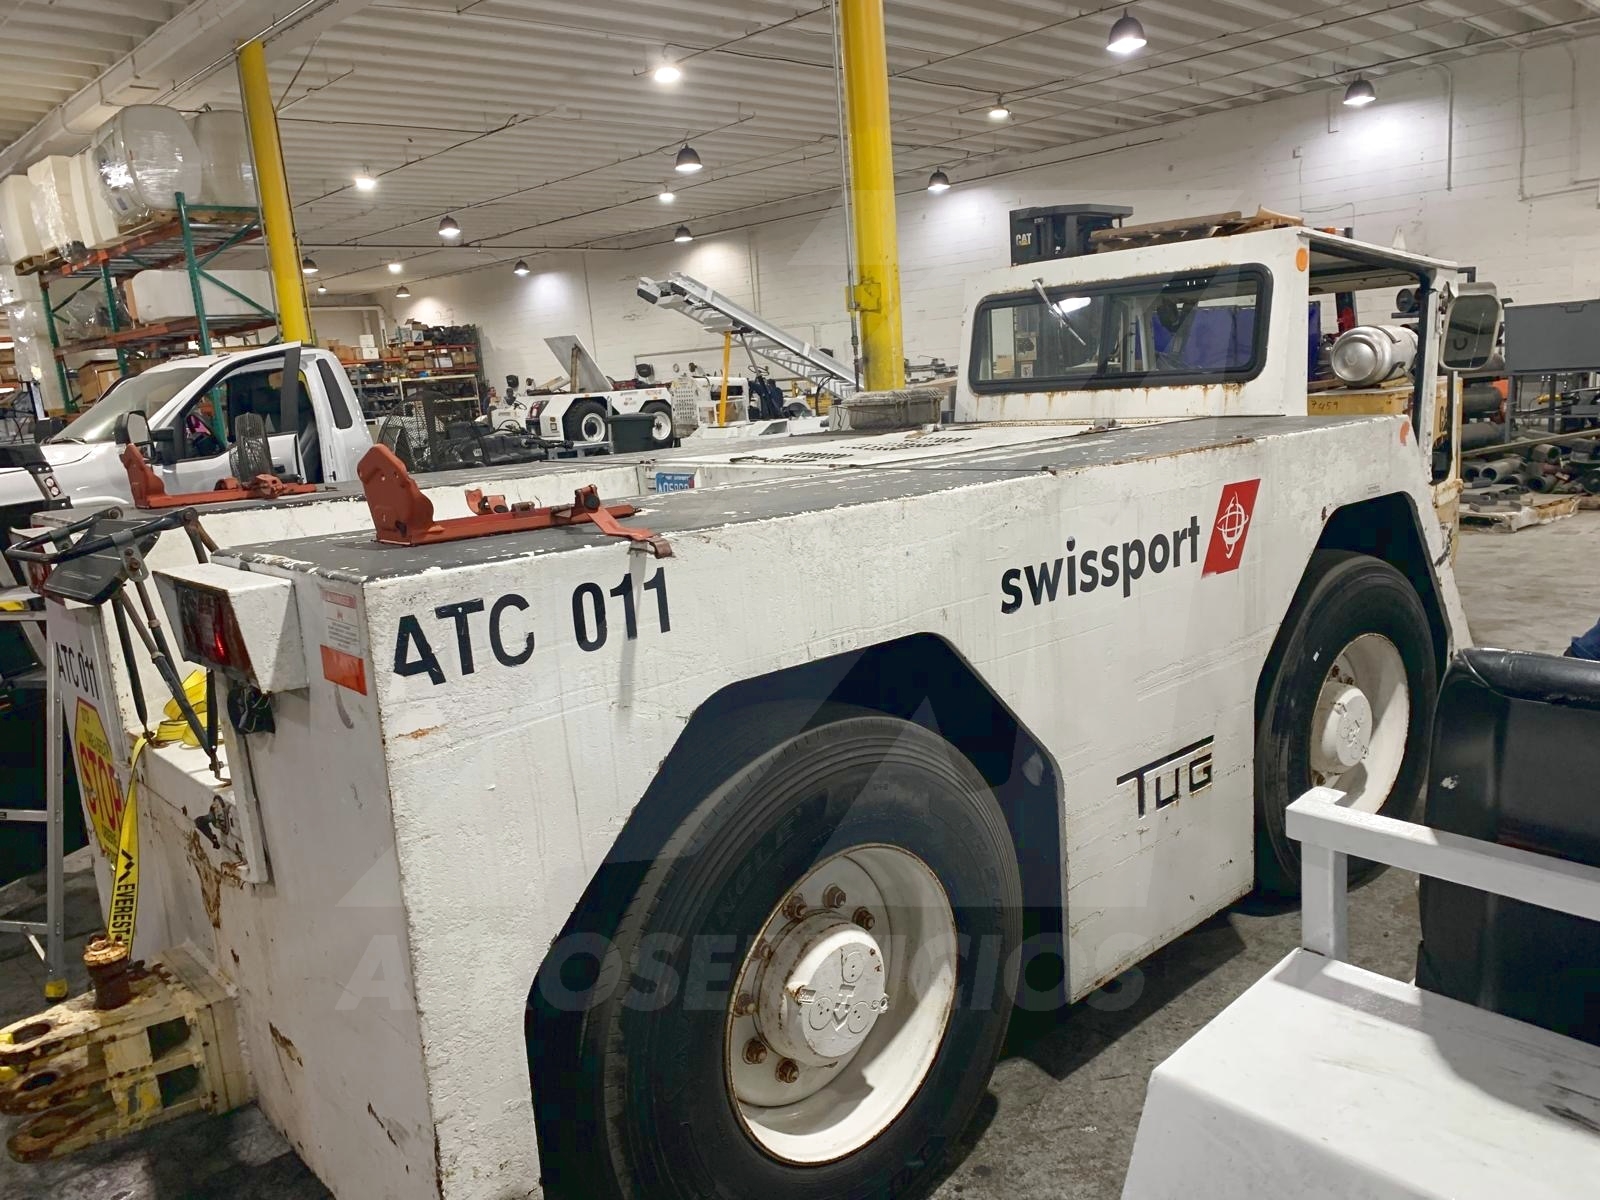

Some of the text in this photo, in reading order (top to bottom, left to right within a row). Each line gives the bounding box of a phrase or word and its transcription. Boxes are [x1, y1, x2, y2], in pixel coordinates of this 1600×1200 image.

[1015, 232, 1032, 246] CAT
[1001, 515, 1200, 615] swissport
[393, 566, 671, 685] ATC 011
[55, 642, 100, 701] ATC 011
[1116, 734, 1215, 820] TUG
[111, 883, 136, 936] EVEREST
